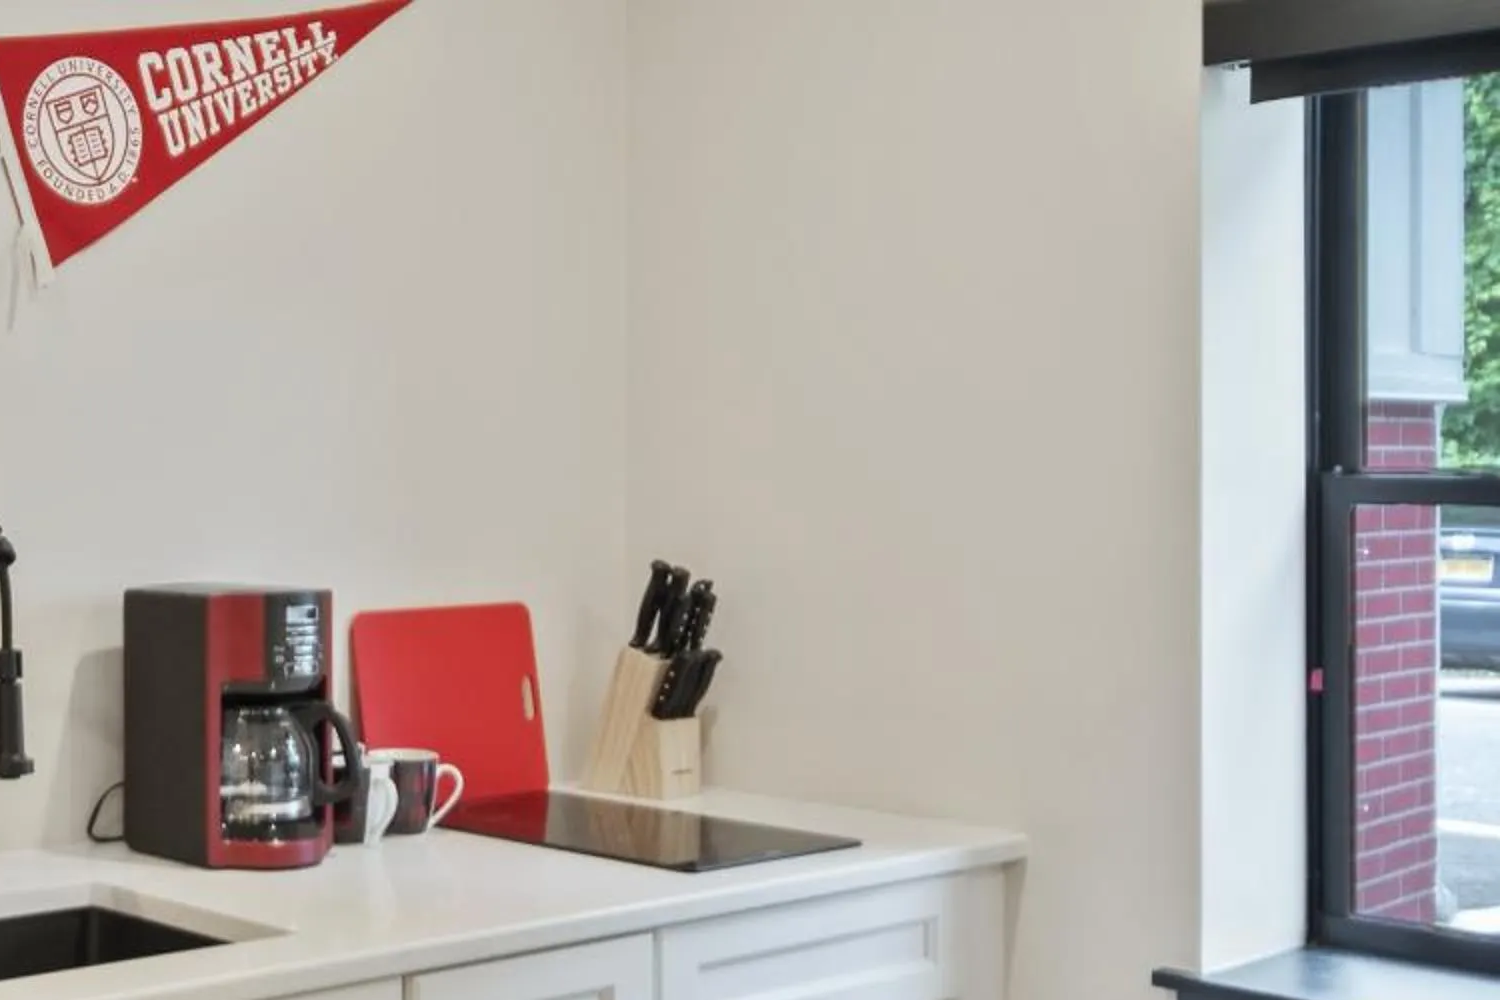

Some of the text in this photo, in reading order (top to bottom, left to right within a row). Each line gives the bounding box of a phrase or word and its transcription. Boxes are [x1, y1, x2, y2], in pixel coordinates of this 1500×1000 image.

[25, 59, 136, 148] CORNELL UNIVERSITY
[138, 21, 337, 112] CORNELL
[158, 43, 337, 157] UNIVERSITY
[37, 158, 106, 201] FOUNDED
